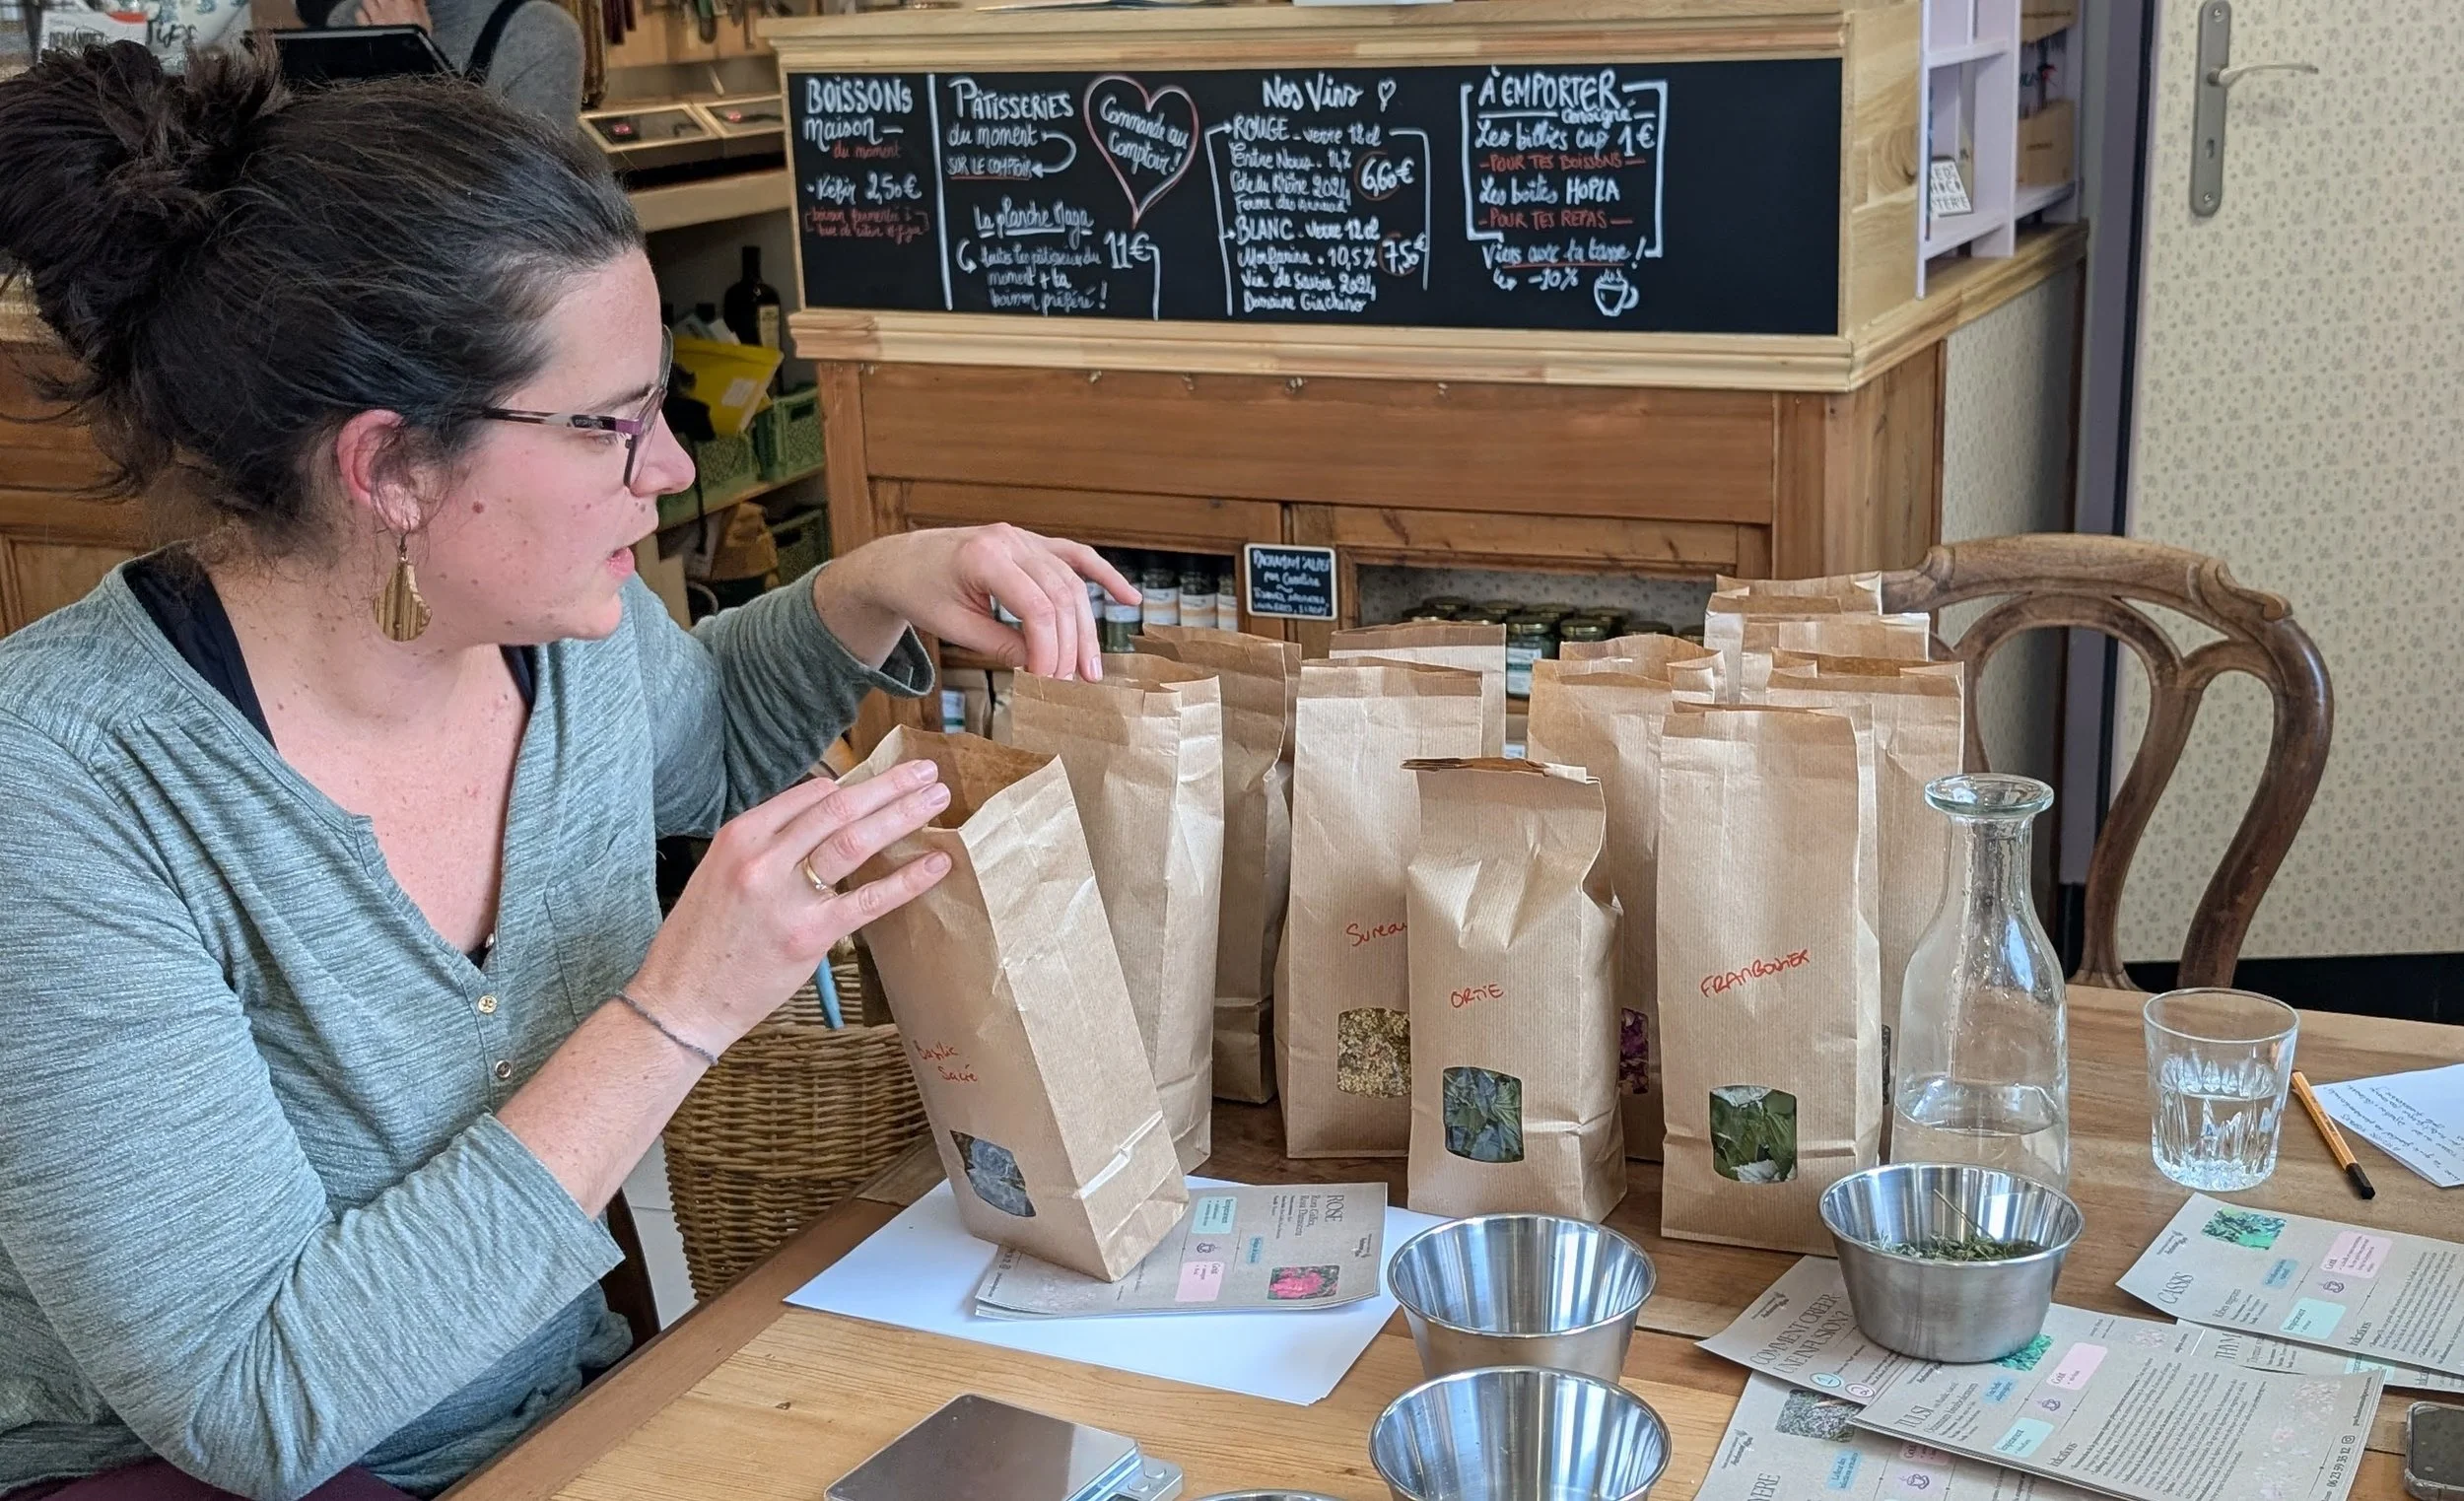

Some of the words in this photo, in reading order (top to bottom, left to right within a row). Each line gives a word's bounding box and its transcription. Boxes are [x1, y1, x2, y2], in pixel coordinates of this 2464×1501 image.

[1263, 74, 1304, 111] Nos
[1305, 71, 1364, 112] Vins
[1501, 69, 1622, 112] EMPORTER
[947, 124, 973, 148] du
[976, 124, 1038, 149] moment
[1100, 95, 1166, 141] Commande
[1167, 125, 1189, 150] au
[1232, 114, 1290, 142] ROUGE
[1475, 118, 1513, 149] Les
[833, 142, 850, 159] du
[855, 141, 901, 159] moment
[947, 156, 970, 175] SUR
[971, 156, 986, 175] LE
[1489, 154, 1526, 172] POUR
[1528, 154, 1554, 171] TES
[1560, 153, 1624, 172] BOISSONS
[865, 171, 923, 205] 2,50€
[1361, 157, 1415, 197] 6,60€
[1479, 174, 1508, 205] Les
[974, 204, 994, 230] La
[996, 195, 1053, 239] planche
[1235, 215, 1294, 245] BLANC
[1489, 208, 1529, 229] POUR
[1531, 210, 1555, 230] TES
[1560, 209, 1608, 229] REPAS
[1104, 231, 1151, 269] 11€
[989, 267, 1036, 287] moment
[1326, 1194, 1345, 1223] ROSE
[2156, 1271, 2195, 1305] CASSIS
[1749, 1321, 1811, 1366] COMMENT
[1893, 1404, 1935, 1428] TULSI
